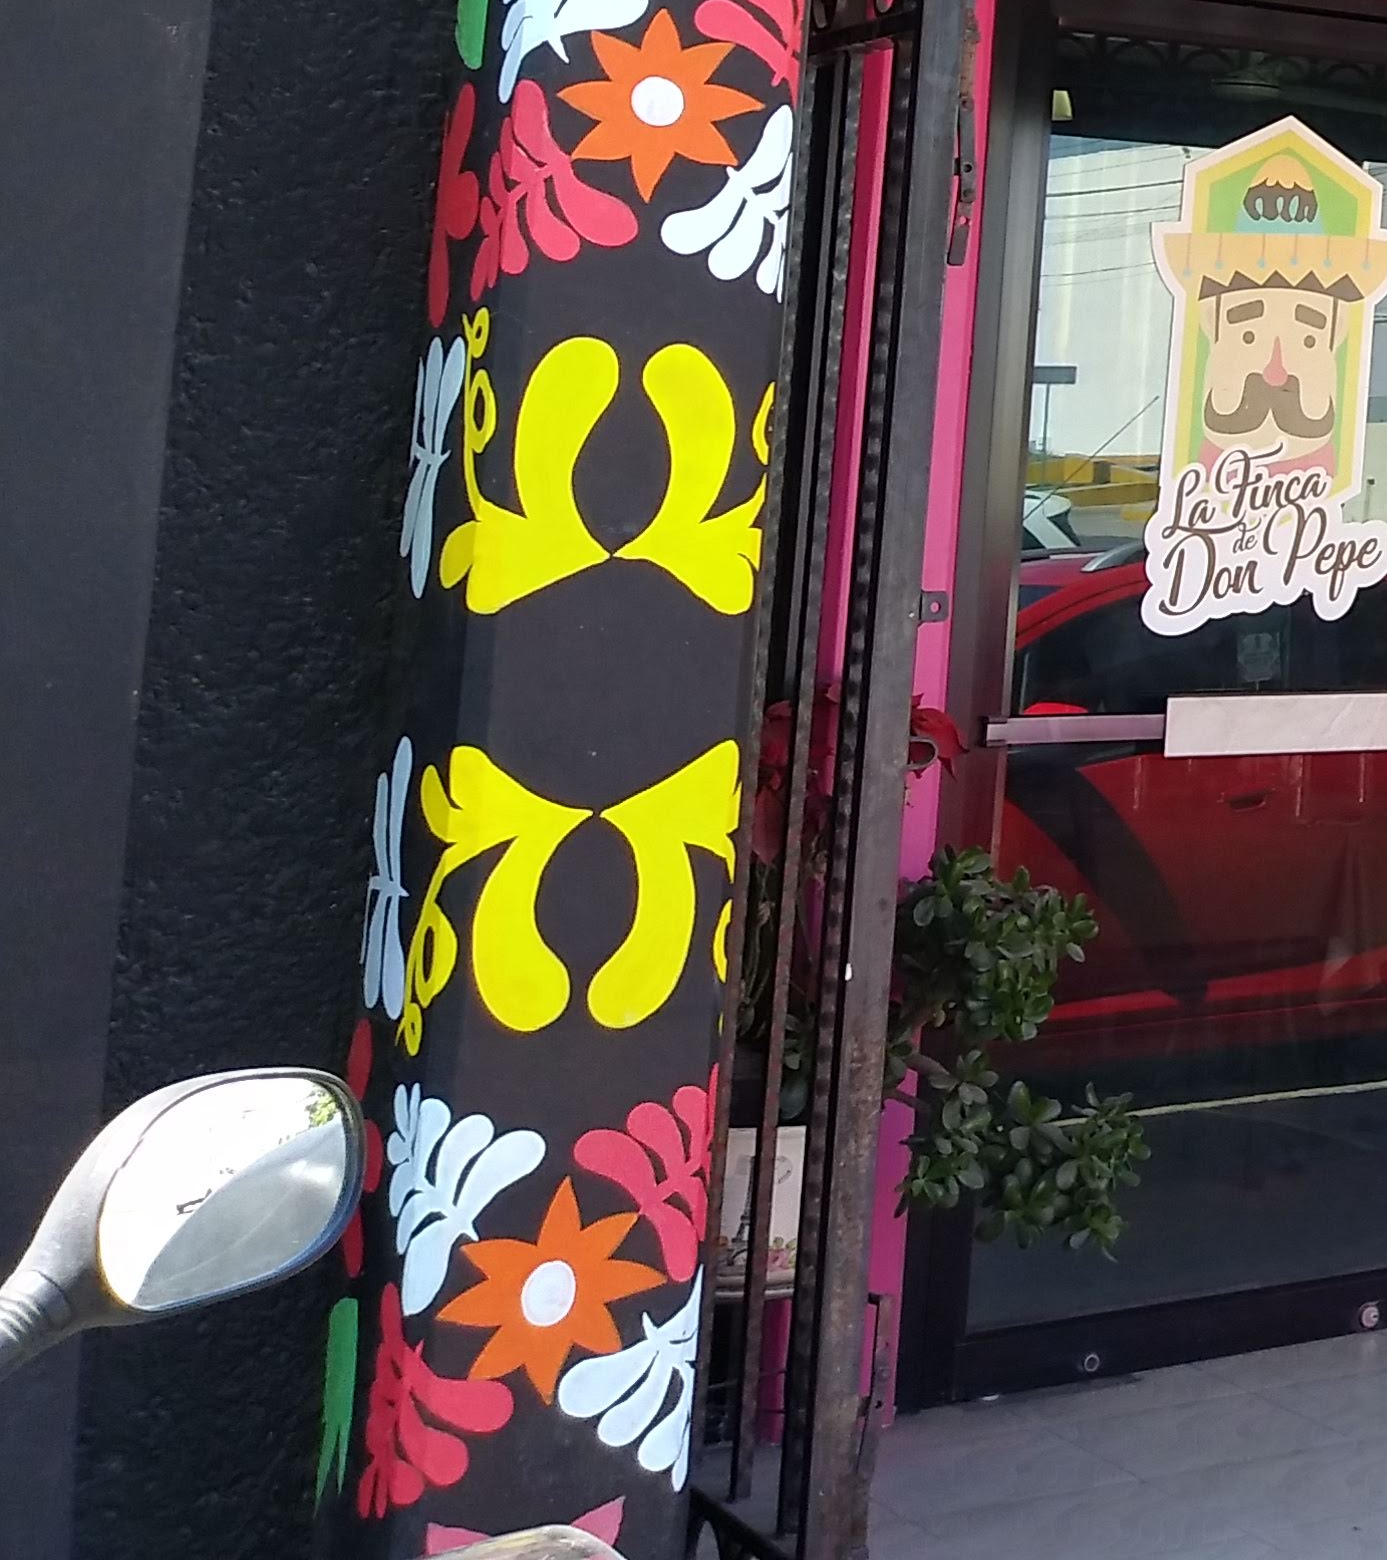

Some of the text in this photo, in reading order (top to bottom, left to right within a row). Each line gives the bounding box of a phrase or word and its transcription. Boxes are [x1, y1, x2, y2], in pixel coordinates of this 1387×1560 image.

[1162, 442, 1327, 539] La Finca
[1233, 516, 1261, 554] de
[1158, 502, 1382, 616] Don Pepe
